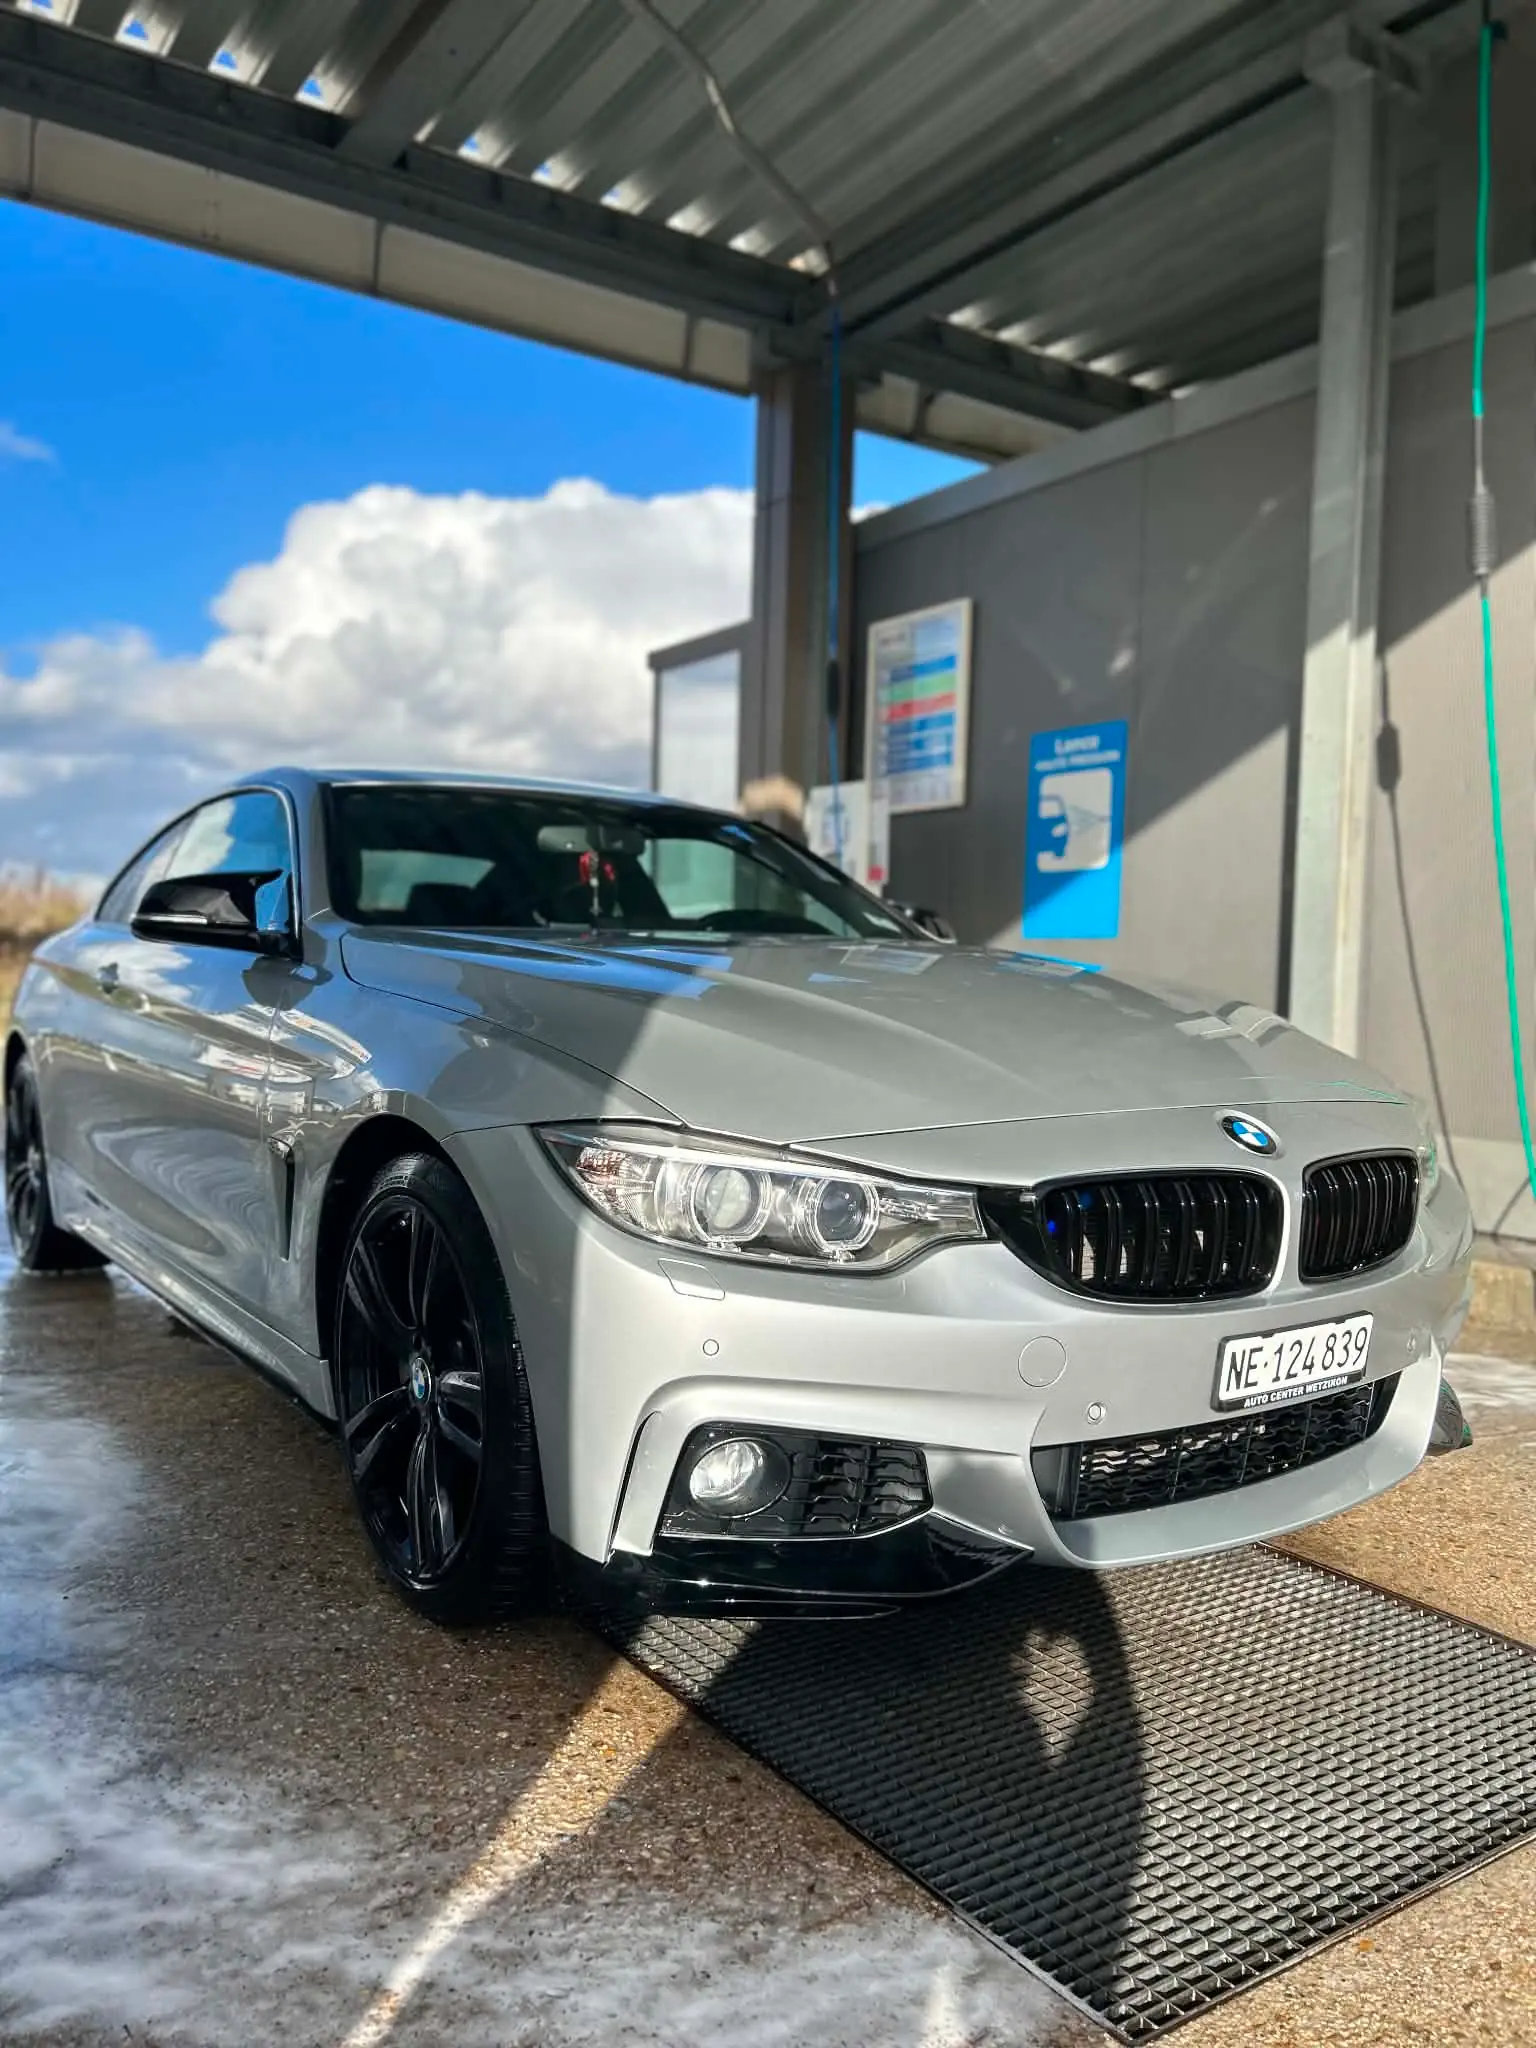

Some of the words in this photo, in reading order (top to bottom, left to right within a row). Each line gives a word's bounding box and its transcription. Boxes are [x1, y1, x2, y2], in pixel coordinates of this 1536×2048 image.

[1244, 1394, 1269, 1408] AUTO
[1270, 1385, 1304, 1402] CENTER
[1306, 1376, 1349, 1394] WETZIKON
